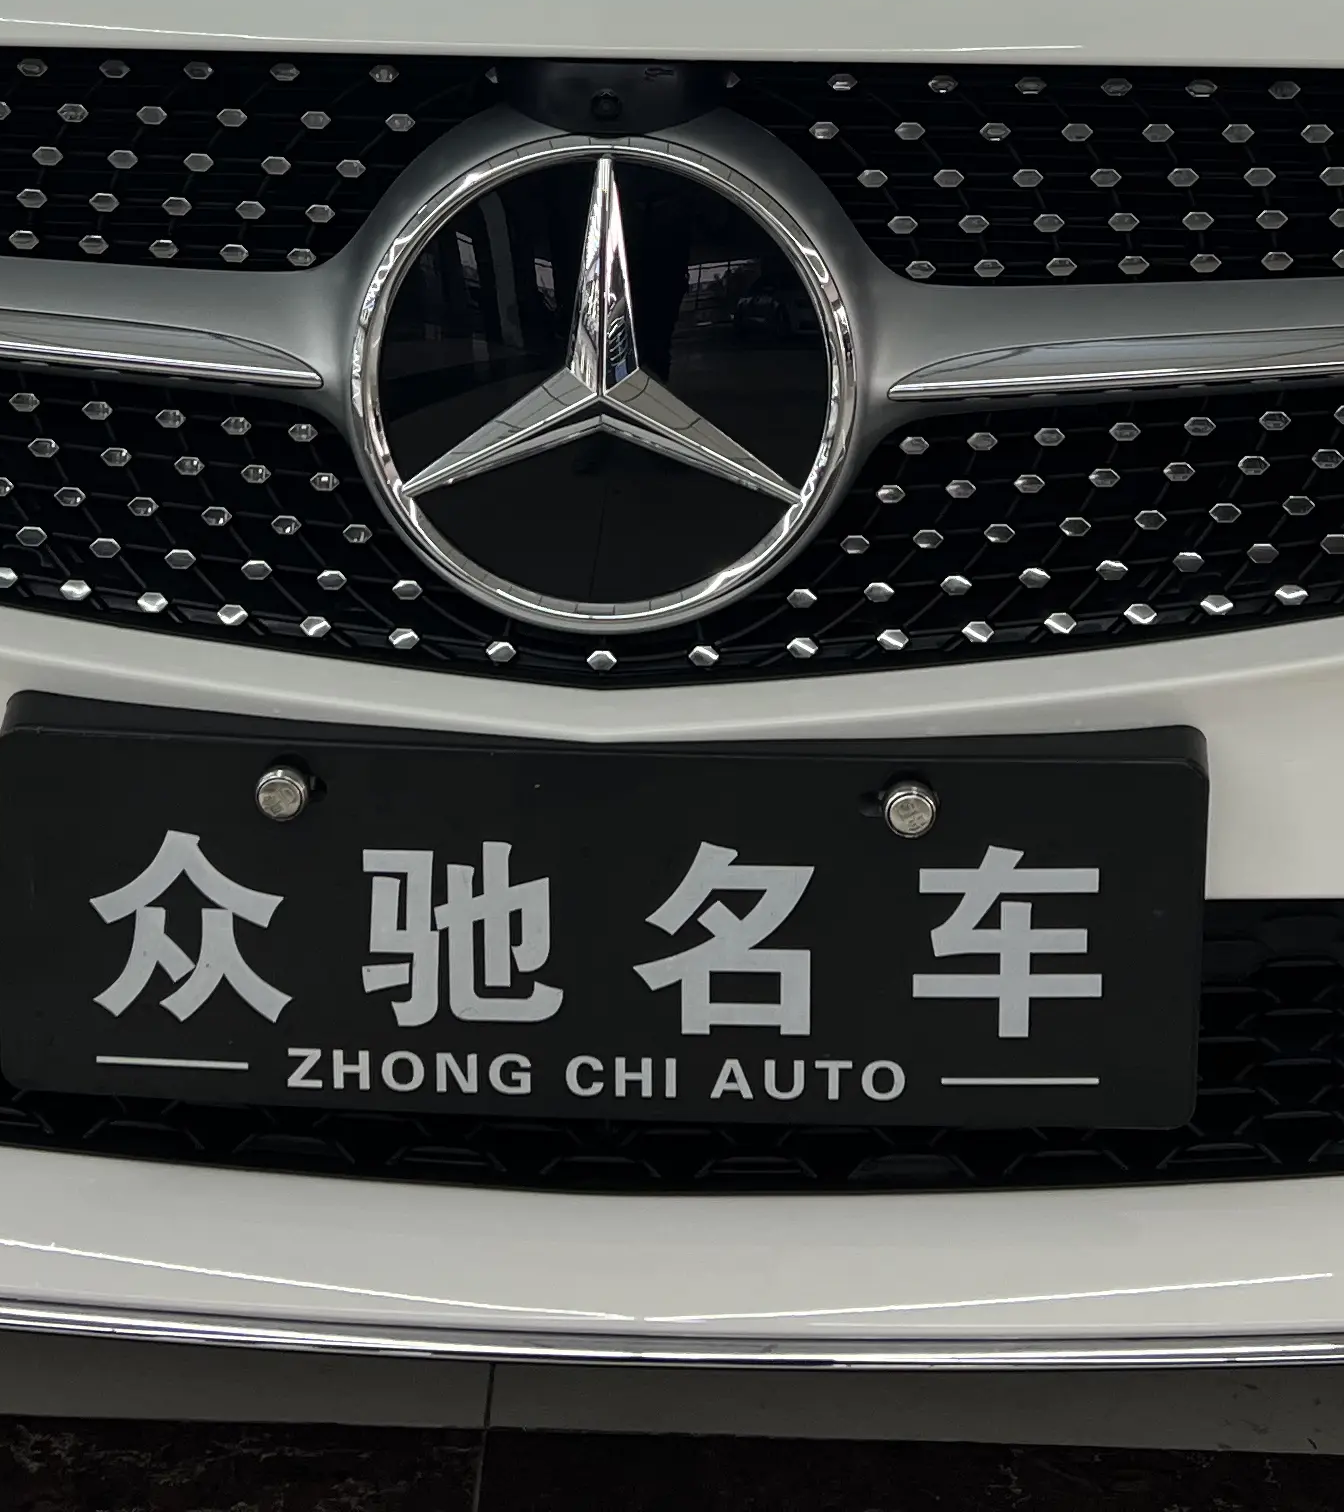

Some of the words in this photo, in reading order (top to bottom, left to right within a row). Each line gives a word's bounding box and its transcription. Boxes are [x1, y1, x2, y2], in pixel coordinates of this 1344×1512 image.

[89, 829, 1103, 1038] 众驰名车
[286, 1047, 532, 1097] ZHONG
[566, 1054, 678, 1101] CHI
[710, 1058, 907, 1103] AUTO
